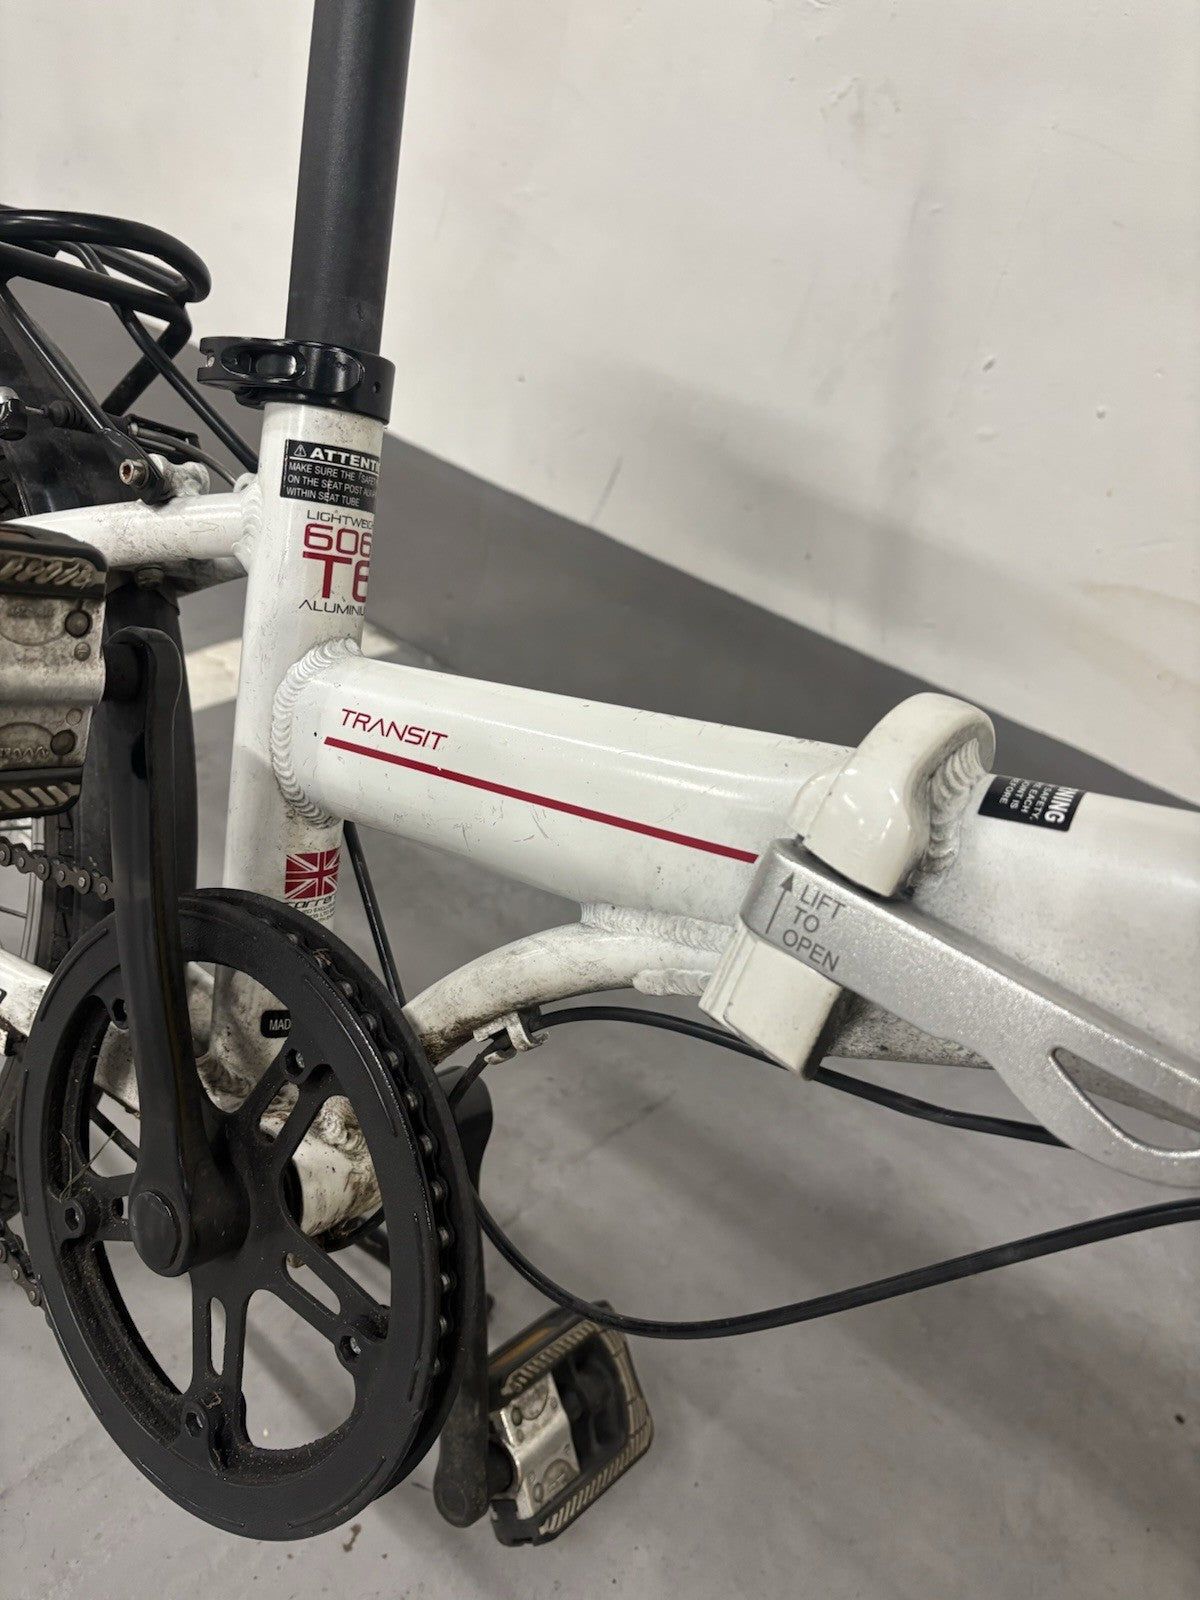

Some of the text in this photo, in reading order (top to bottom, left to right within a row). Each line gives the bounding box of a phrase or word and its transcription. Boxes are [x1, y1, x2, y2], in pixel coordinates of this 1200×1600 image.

[287, 474, 300, 485] ON
[302, 476, 319, 488] THE
[321, 479, 343, 491] SEAT
[344, 483, 363, 496] POST
[288, 462, 313, 475] MAKE
[314, 466, 338, 478] SURE
[341, 469, 356, 481] THE
[286, 486, 360, 507] WITHIN SEAT TUBE
[342, 708, 449, 750] TRANSIT
[1020, 788, 1039, 814] EACH
[799, 884, 846, 919] LIFT
[793, 905, 820, 933] TO
[782, 929, 840, 973] OPEN
